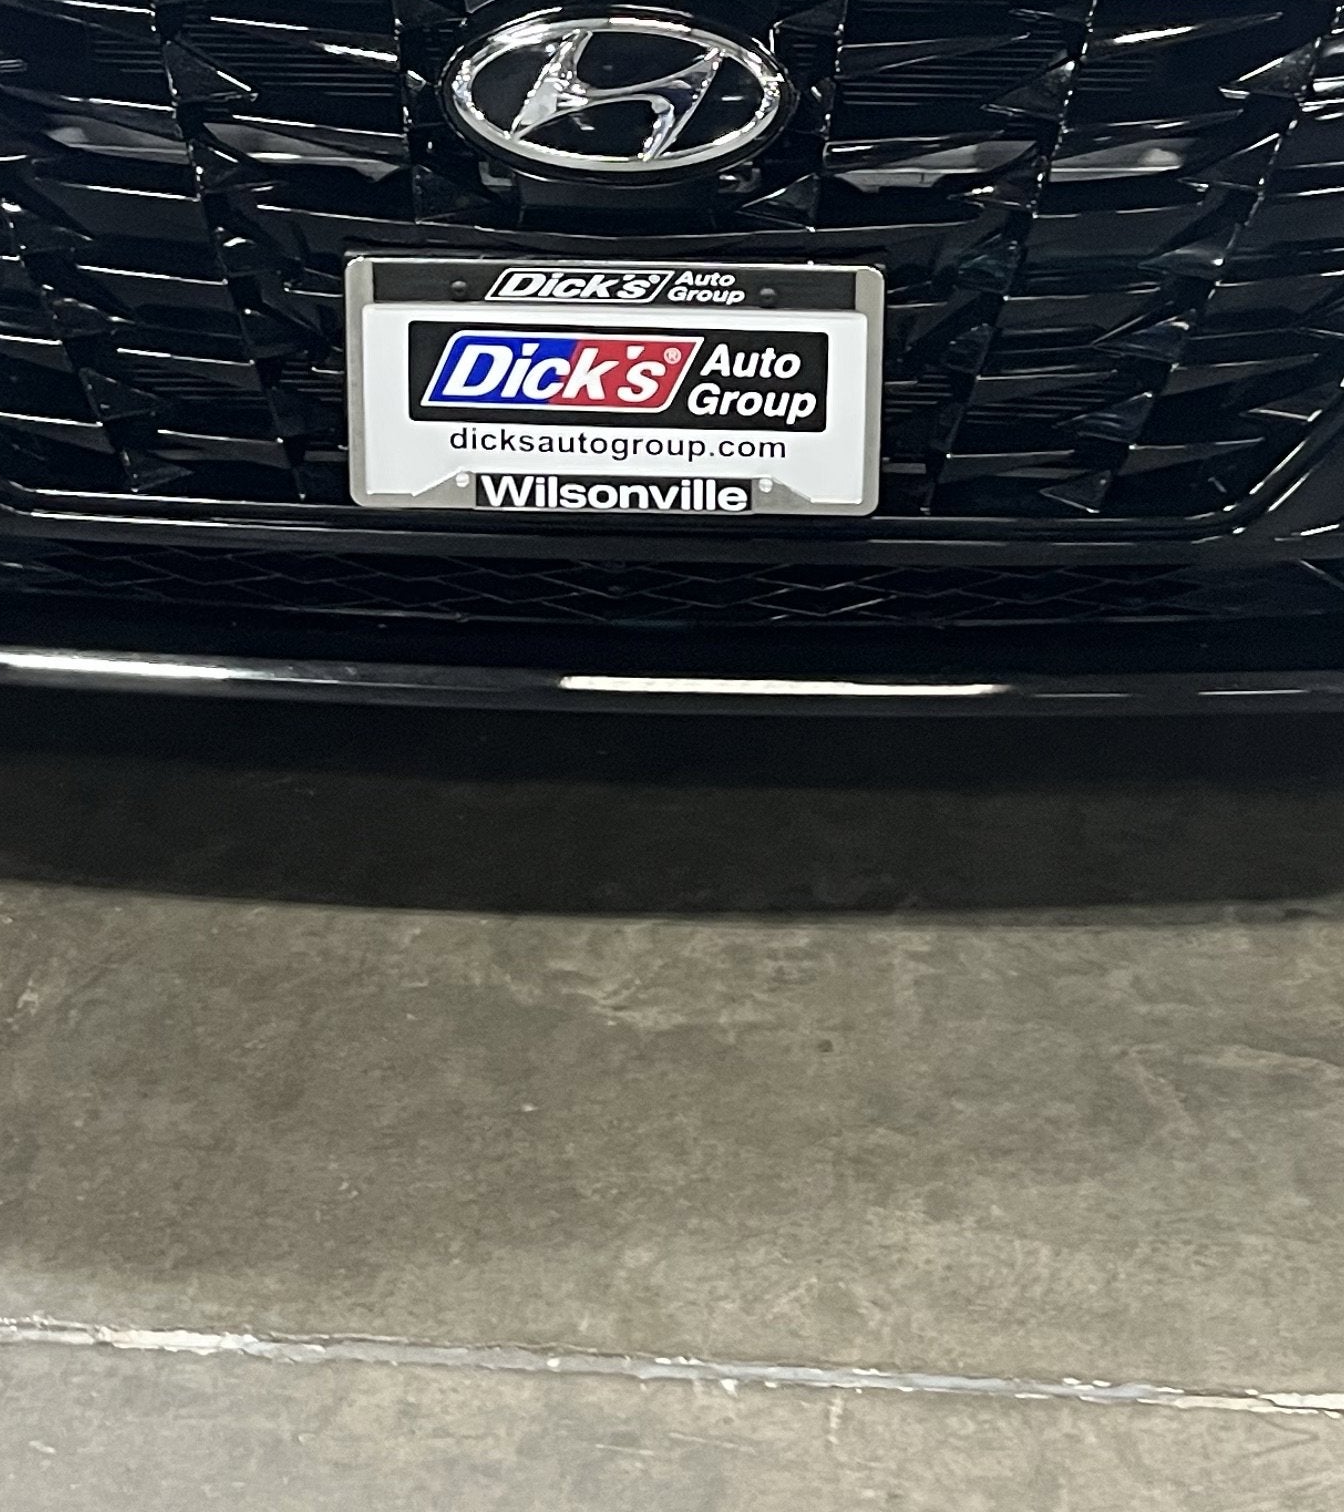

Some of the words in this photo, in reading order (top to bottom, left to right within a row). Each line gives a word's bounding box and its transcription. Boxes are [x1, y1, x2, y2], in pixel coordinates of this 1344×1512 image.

[497, 272, 652, 300] Dick's
[666, 286, 746, 306] Group
[674, 270, 737, 288] Auto
[441, 342, 667, 405] Dick's
[699, 342, 802, 380] Auto
[686, 381, 818, 425] Group
[449, 427, 787, 463] dicksautogroup.com
[478, 474, 750, 513] Wilsonville
